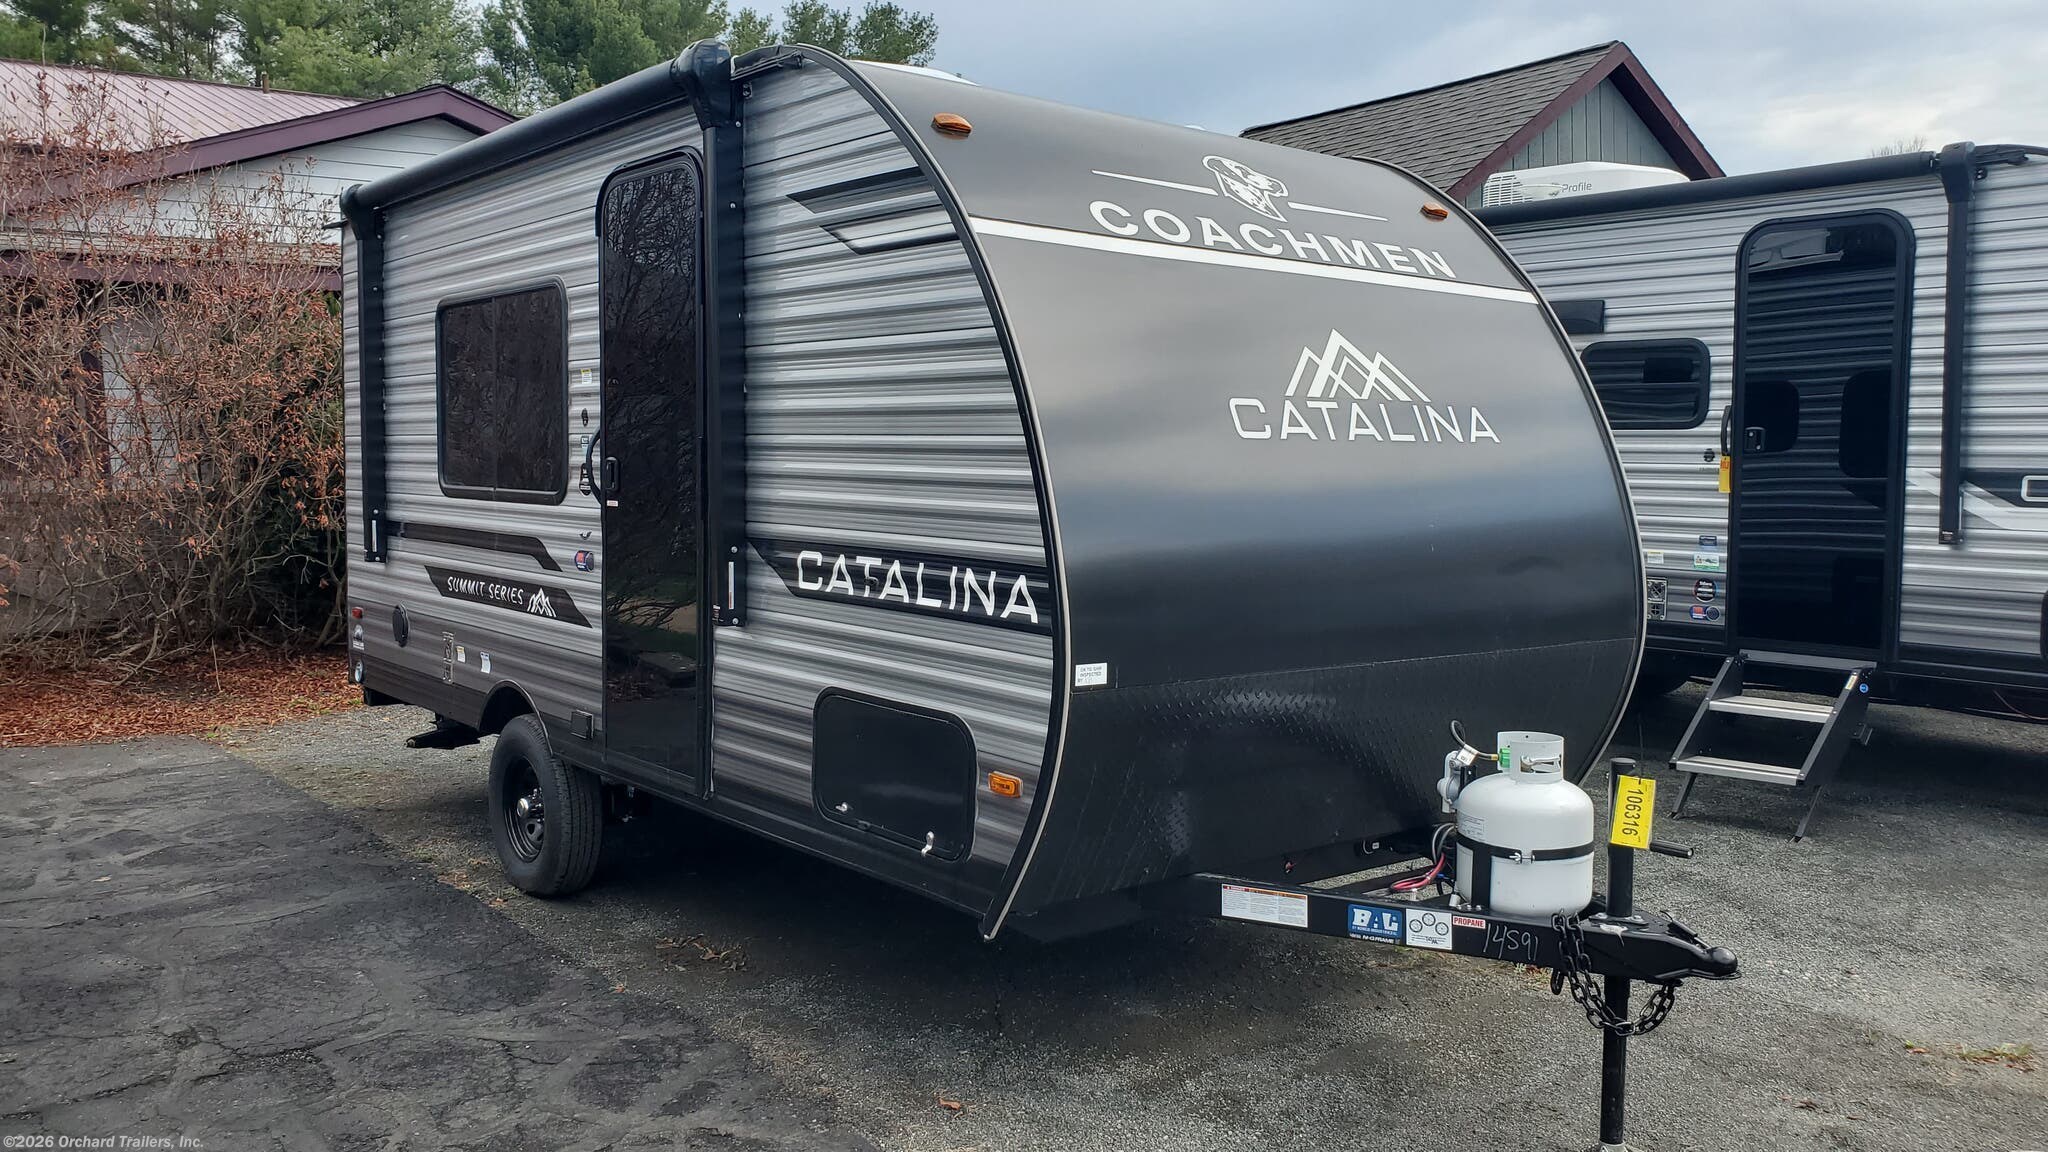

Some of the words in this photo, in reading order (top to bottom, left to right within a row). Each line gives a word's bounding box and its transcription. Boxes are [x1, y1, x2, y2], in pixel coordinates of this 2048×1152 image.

[1562, 182, 1592, 193] Profile
[1088, 199, 1457, 279] COACHMEN
[1229, 397, 1501, 443] CATALINA
[447, 576, 485, 597] SUMMIT
[488, 583, 524, 605] SERIES
[796, 550, 1040, 624] CATALINA
[1622, 789, 1644, 836] 106316
[1352, 908, 1398, 931] BAL
[1453, 916, 1485, 928] PROPANE
